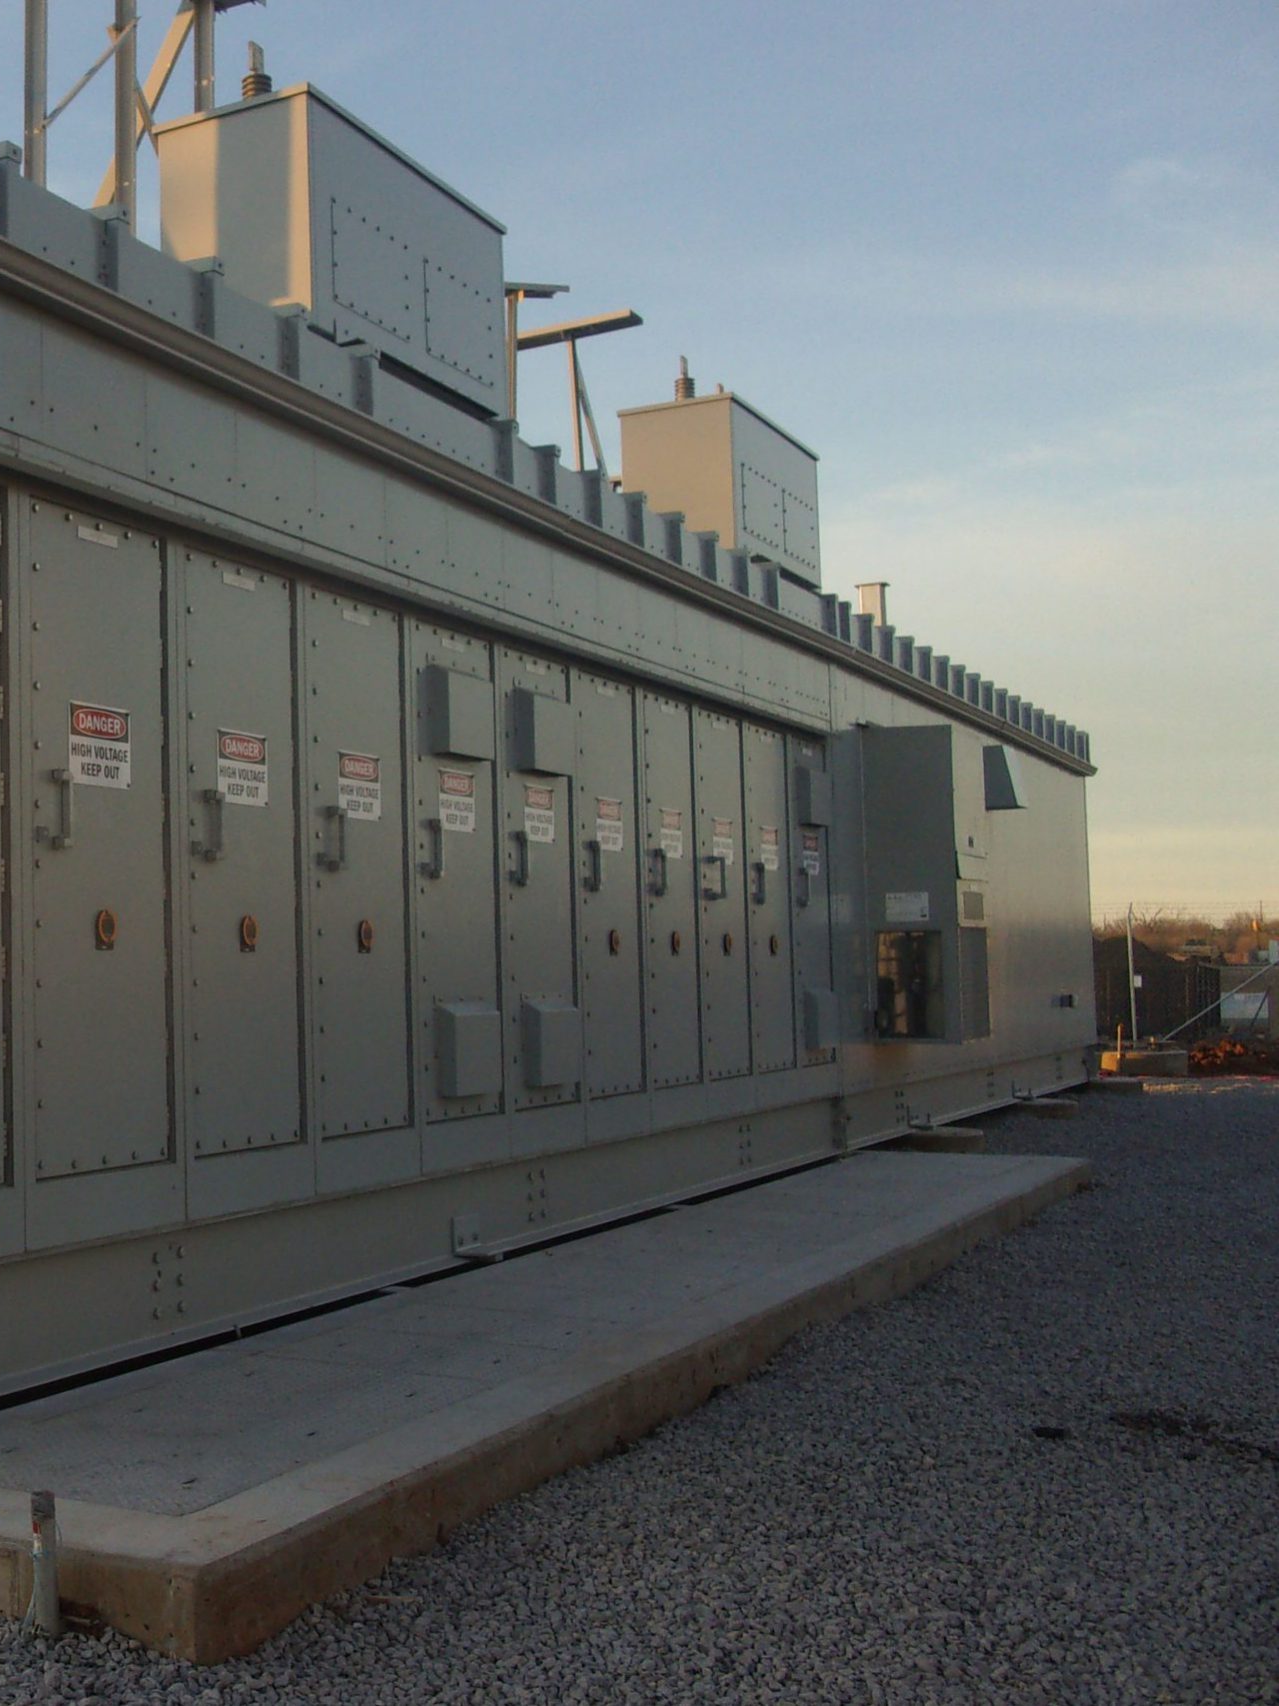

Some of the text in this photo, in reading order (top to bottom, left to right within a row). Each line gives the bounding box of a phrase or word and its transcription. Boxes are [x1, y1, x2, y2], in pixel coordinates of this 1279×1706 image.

[79, 713, 121, 735] DANGER
[71, 742, 128, 763] HIGH VOLTAGE
[225, 739, 260, 757] DANGER
[81, 762, 119, 780] KEEP OUT
[219, 764, 266, 783] HIGH VOLTAGE
[344, 759, 375, 776] DANGER
[227, 783, 259, 799] KEEP OUT
[340, 783, 379, 800] HIGH VOLTAGE
[346, 799, 361, 812] KEEP
